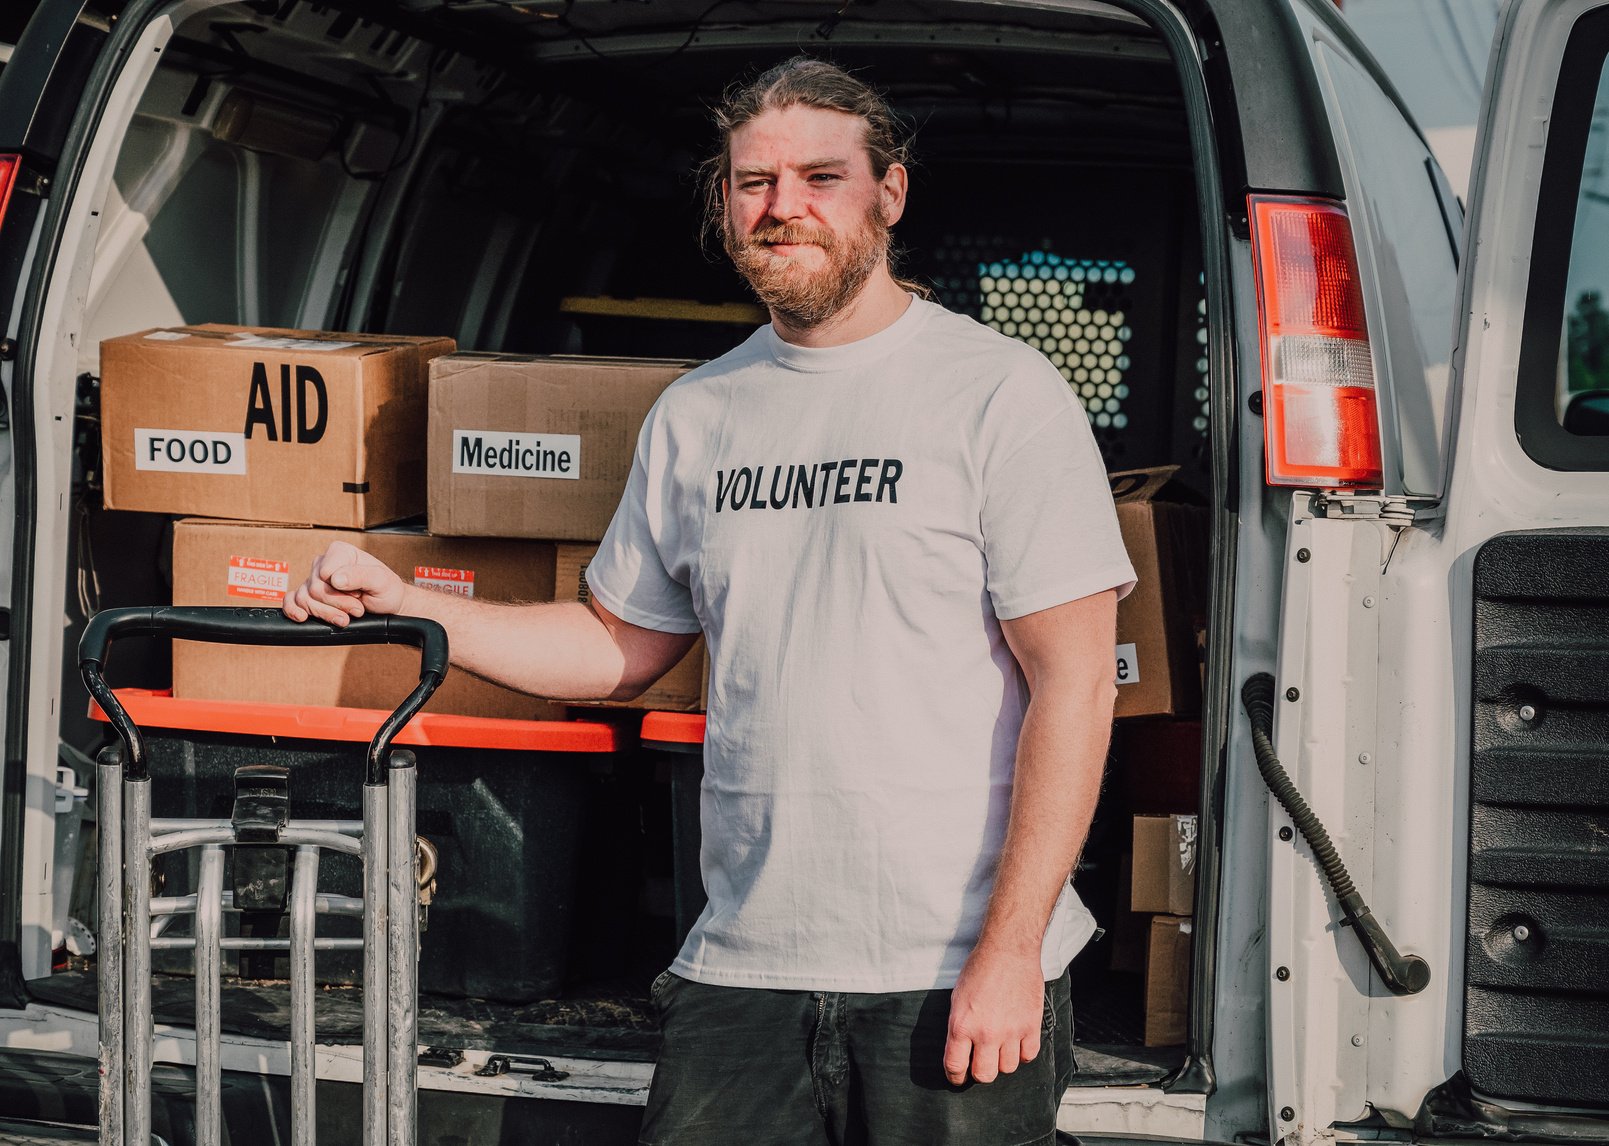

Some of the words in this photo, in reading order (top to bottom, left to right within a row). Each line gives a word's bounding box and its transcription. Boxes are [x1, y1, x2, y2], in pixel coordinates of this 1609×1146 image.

[244, 362, 328, 445] AID
[149, 437, 232, 465] FOOD
[460, 436, 571, 473] Medicine
[716, 458, 903, 513] VOLUNTEER
[234, 571, 283, 587] FRAGILE
